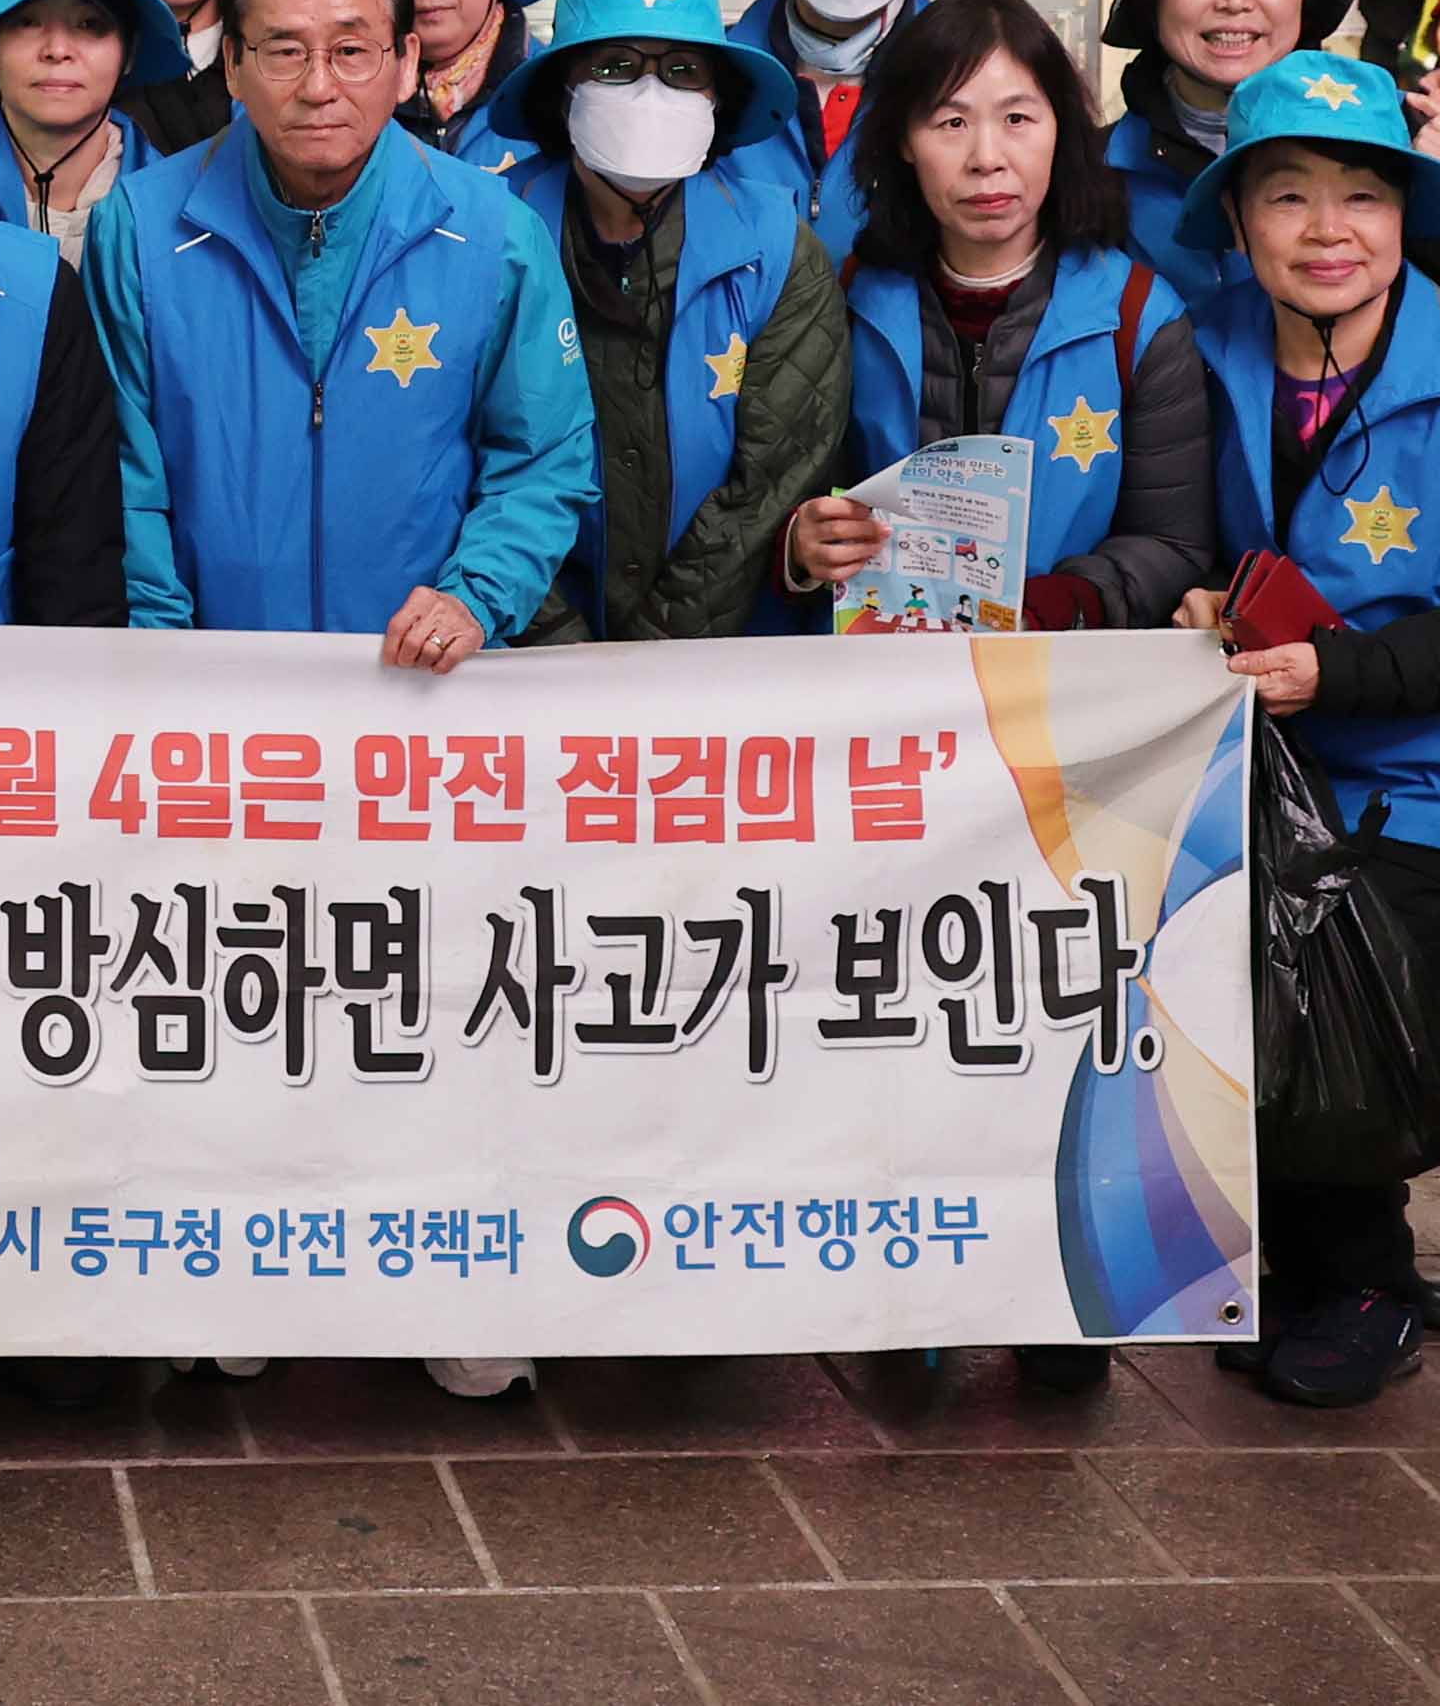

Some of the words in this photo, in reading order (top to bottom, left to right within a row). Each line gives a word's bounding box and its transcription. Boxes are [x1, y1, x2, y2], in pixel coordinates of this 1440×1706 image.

[90, 733, 326, 841] 4일은
[356, 736, 527, 843] 안전
[557, 737, 816, 845] 점검의
[1, 883, 432, 1083] 방심하면
[465, 887, 793, 1082] 사고가
[819, 879, 1167, 1080] 보인다.
[65, 1208, 222, 1278] 동구청
[246, 1210, 347, 1278] 안전
[369, 1210, 525, 1279] 정책과
[665, 1197, 990, 1272] 안전행정부
